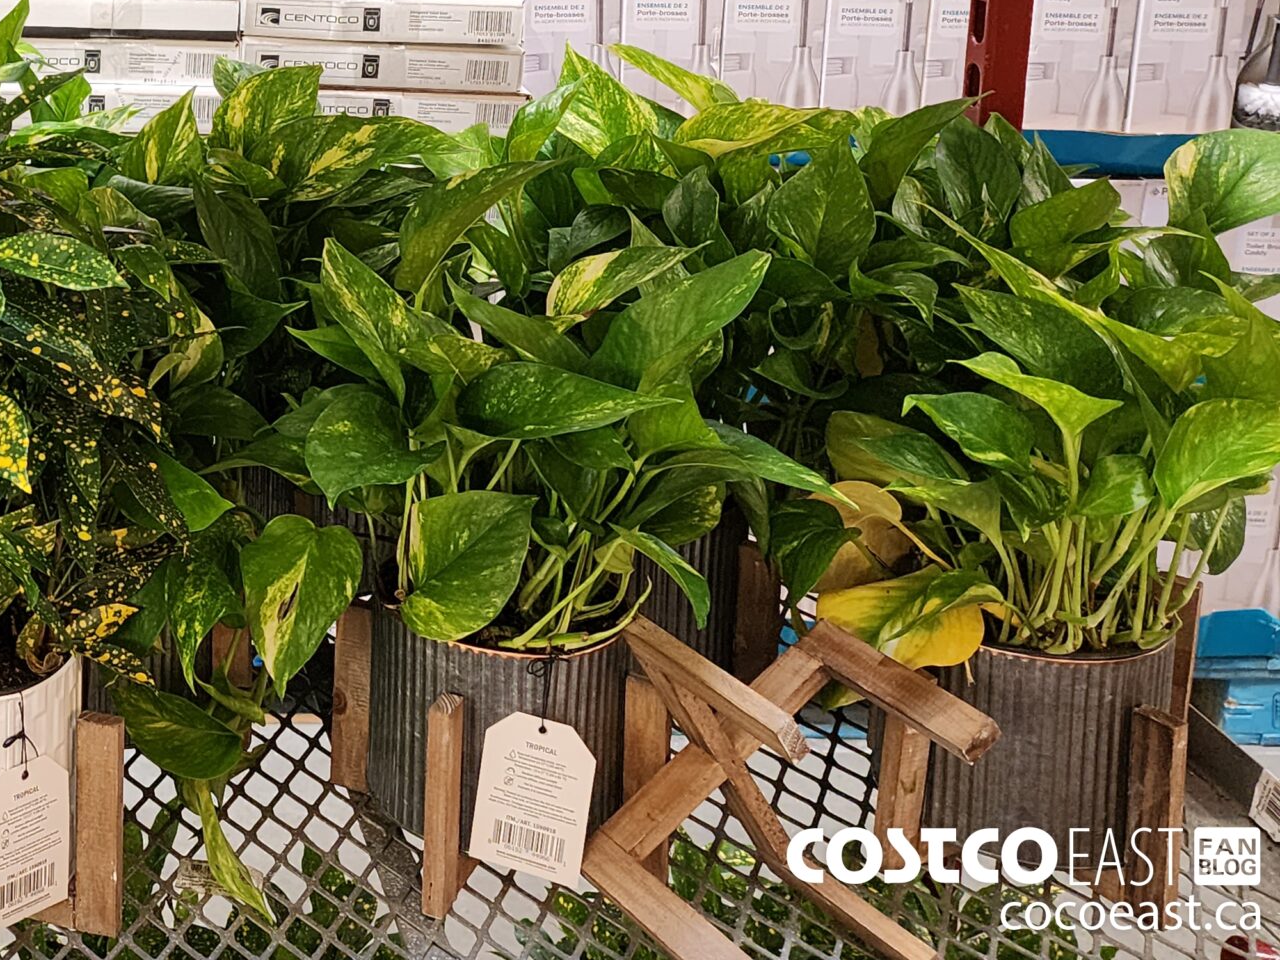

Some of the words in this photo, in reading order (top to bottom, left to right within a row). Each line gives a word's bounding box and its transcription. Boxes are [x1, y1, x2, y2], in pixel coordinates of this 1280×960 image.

[284, 13, 360, 24] CENTOCO
[526, 741, 558, 756] TROPICAL
[14, 785, 40, 801] TROPICAL
